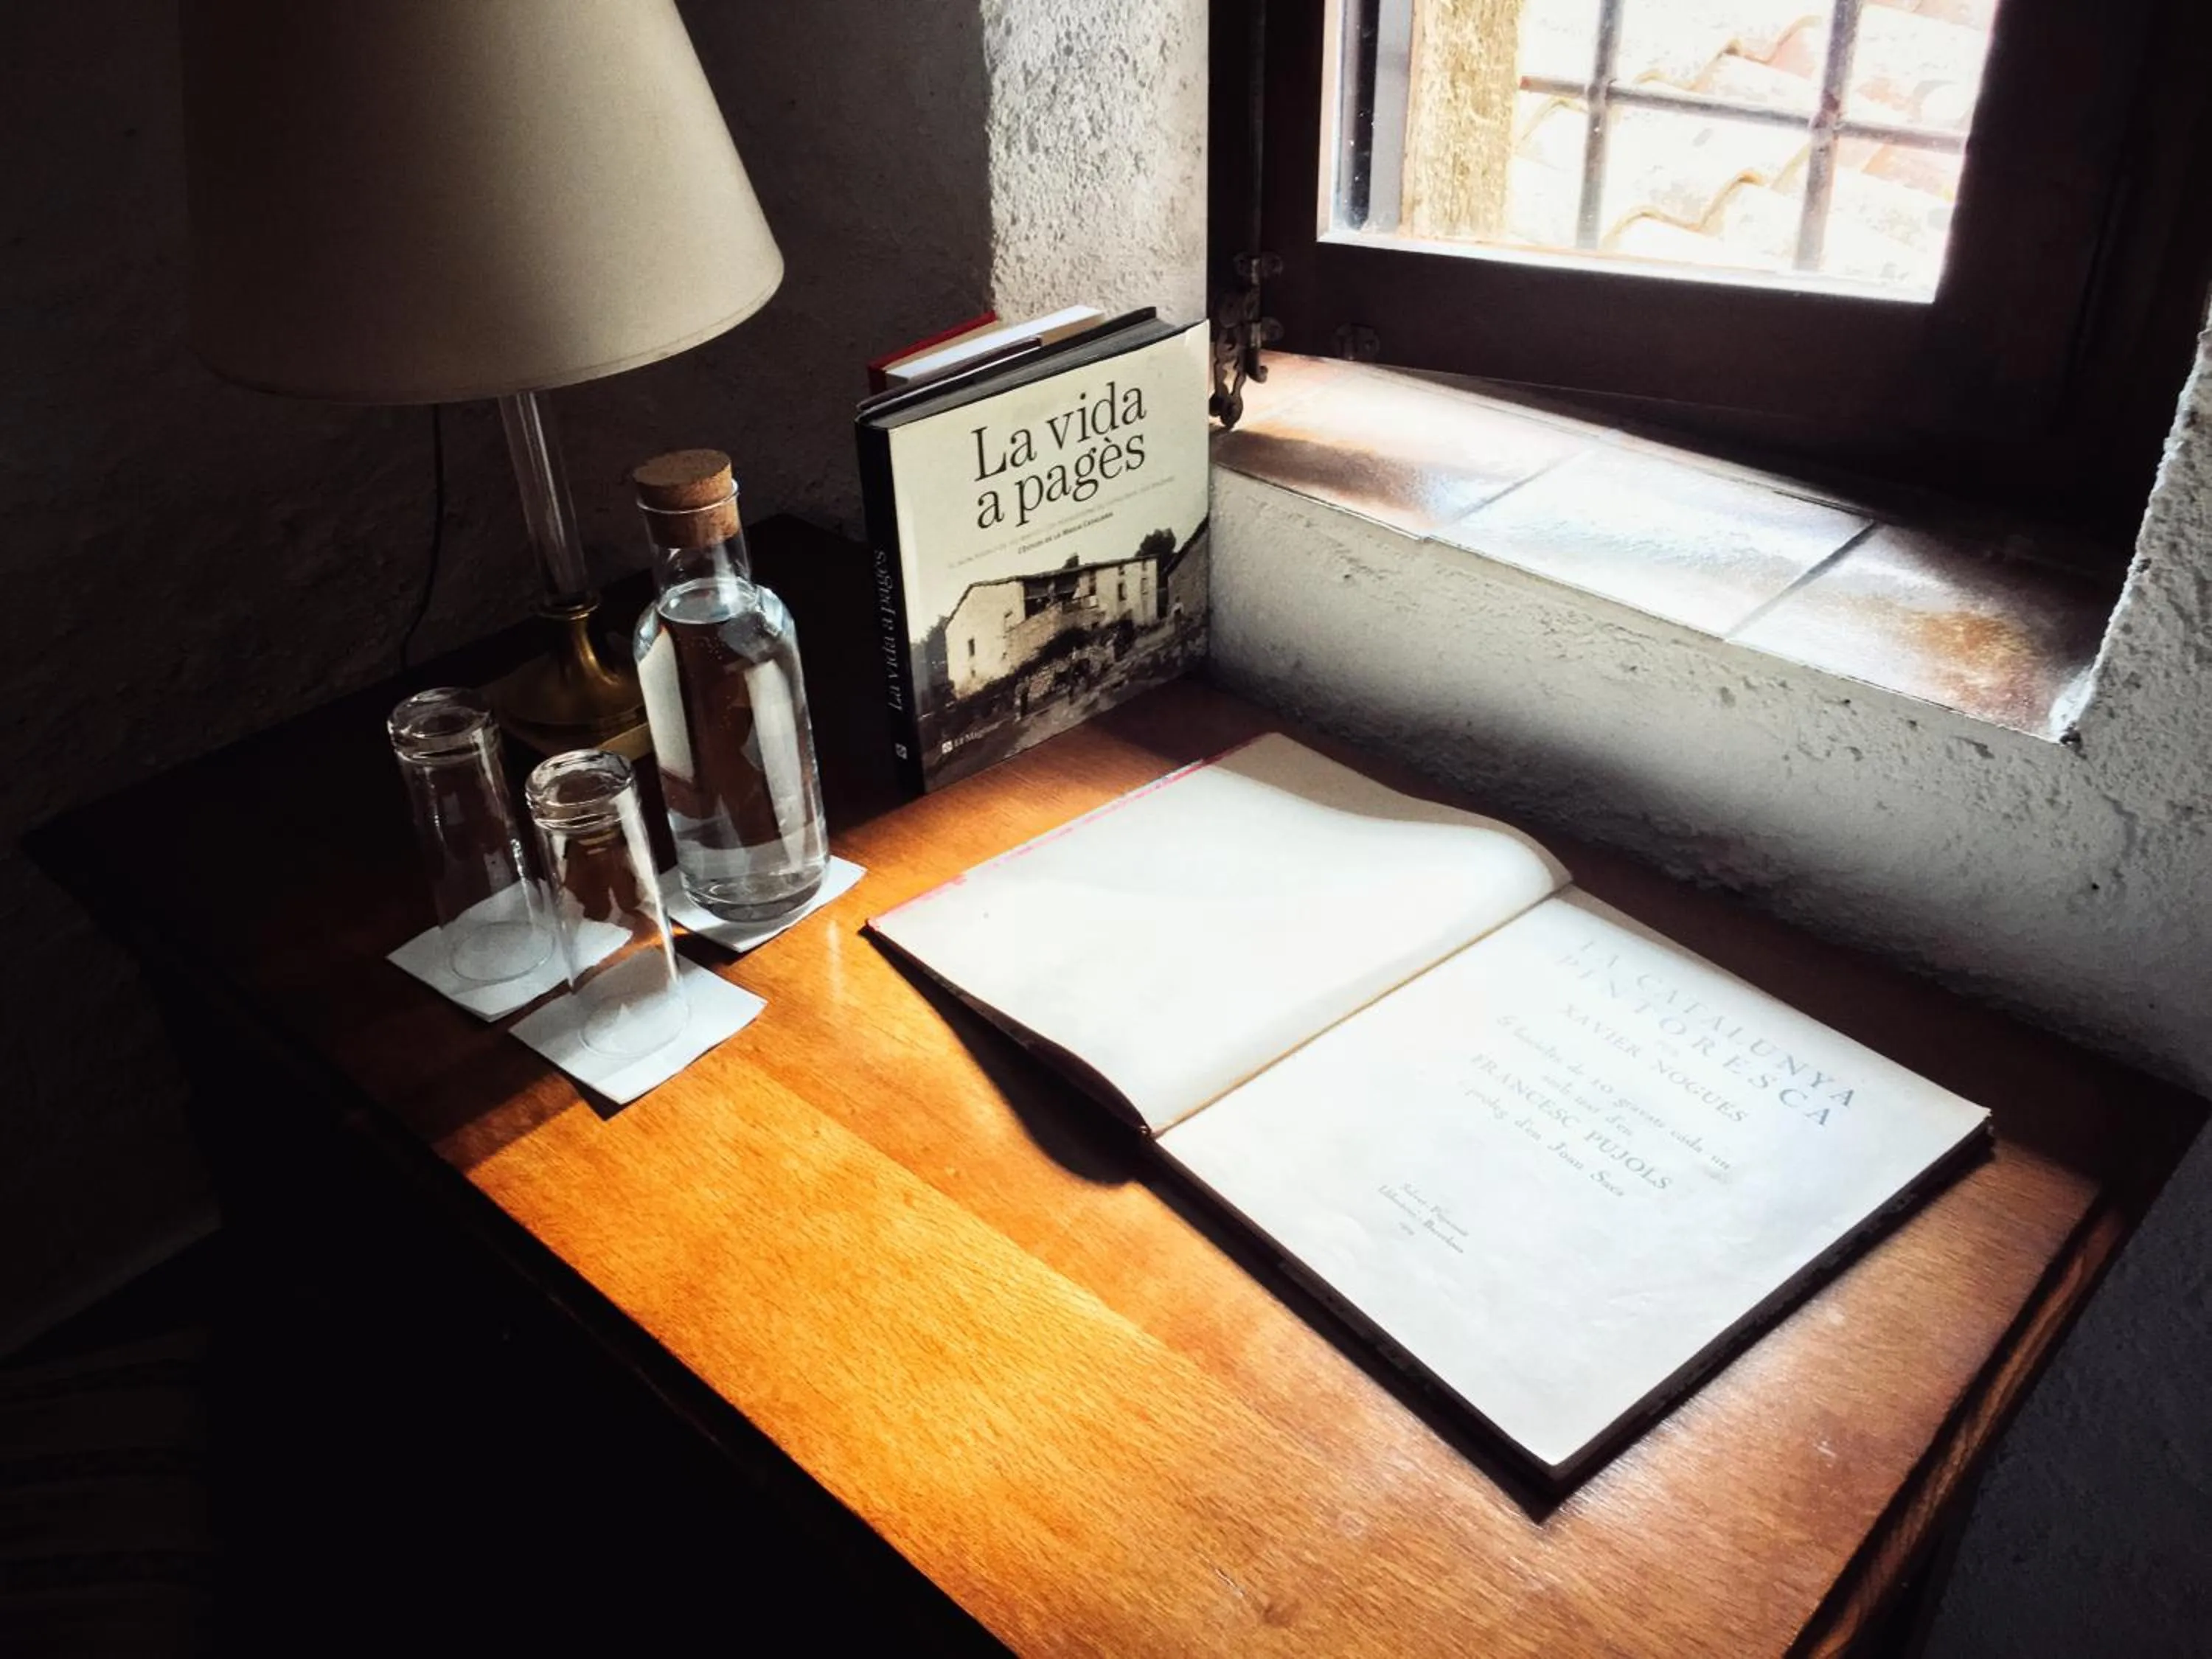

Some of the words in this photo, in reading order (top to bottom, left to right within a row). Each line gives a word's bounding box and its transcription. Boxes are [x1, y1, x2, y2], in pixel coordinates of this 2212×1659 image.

[971, 425, 1037, 481] La
[1046, 381, 1147, 450] vida
[977, 490, 1005, 529] a
[1014, 434, 1146, 526] pagès
[1557, 955, 1830, 1126] PINTORESCA
[1559, 1002, 1641, 1058] XAVIER
[1637, 975, 1854, 1107] CATALUNYA
[1470, 1053, 1580, 1127] FRANCESC
[1583, 1130, 1672, 1189] PUJOLS
